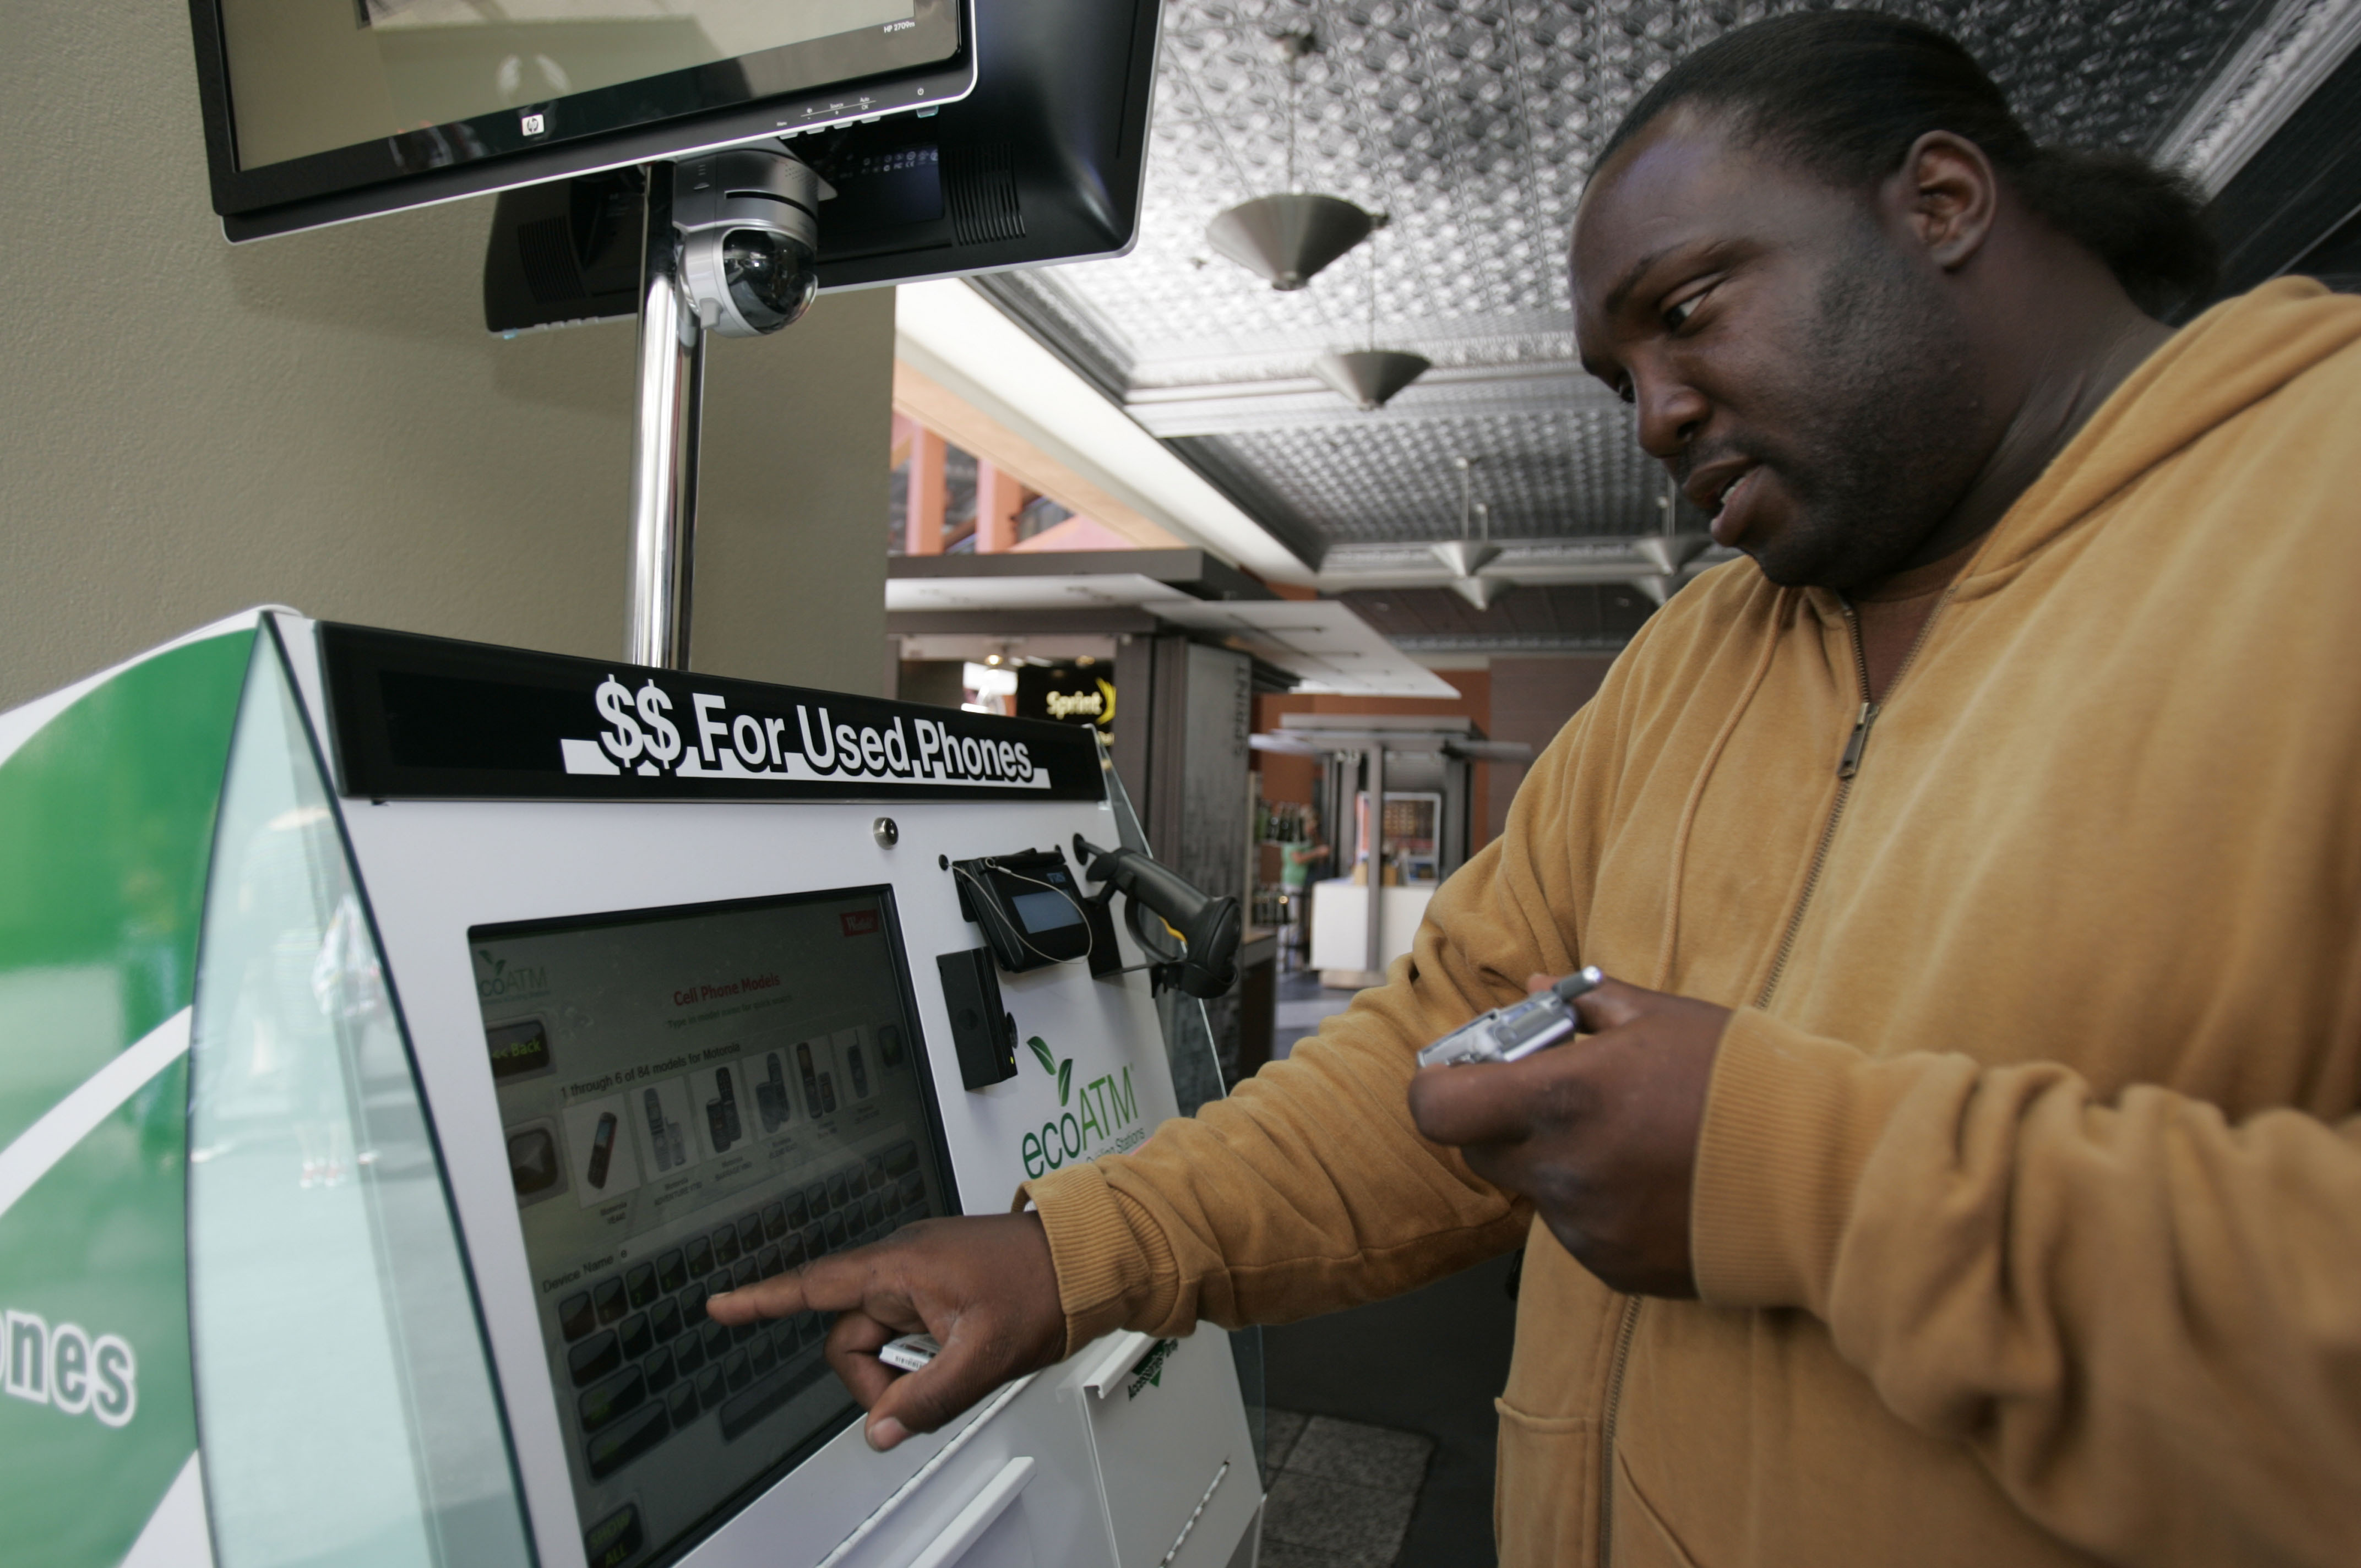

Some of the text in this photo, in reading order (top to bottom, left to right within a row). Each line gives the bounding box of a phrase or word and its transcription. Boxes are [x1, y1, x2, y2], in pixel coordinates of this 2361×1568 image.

[883, 25, 893, 33] HP
[595, 673, 1033, 776] $$ For Used Phones
[1046, 691, 1102, 720] Sprint
[673, 973, 781, 1006] Cell Phone Models
[510, 1037, 541, 1057] Back
[561, 1042, 741, 1098] 1 through 6 of 84 models for Motorola
[1022, 1065, 1138, 1179] ecoATM
[542, 1249, 628, 1293] Device Name e
[0, 1309, 136, 1427] nes
